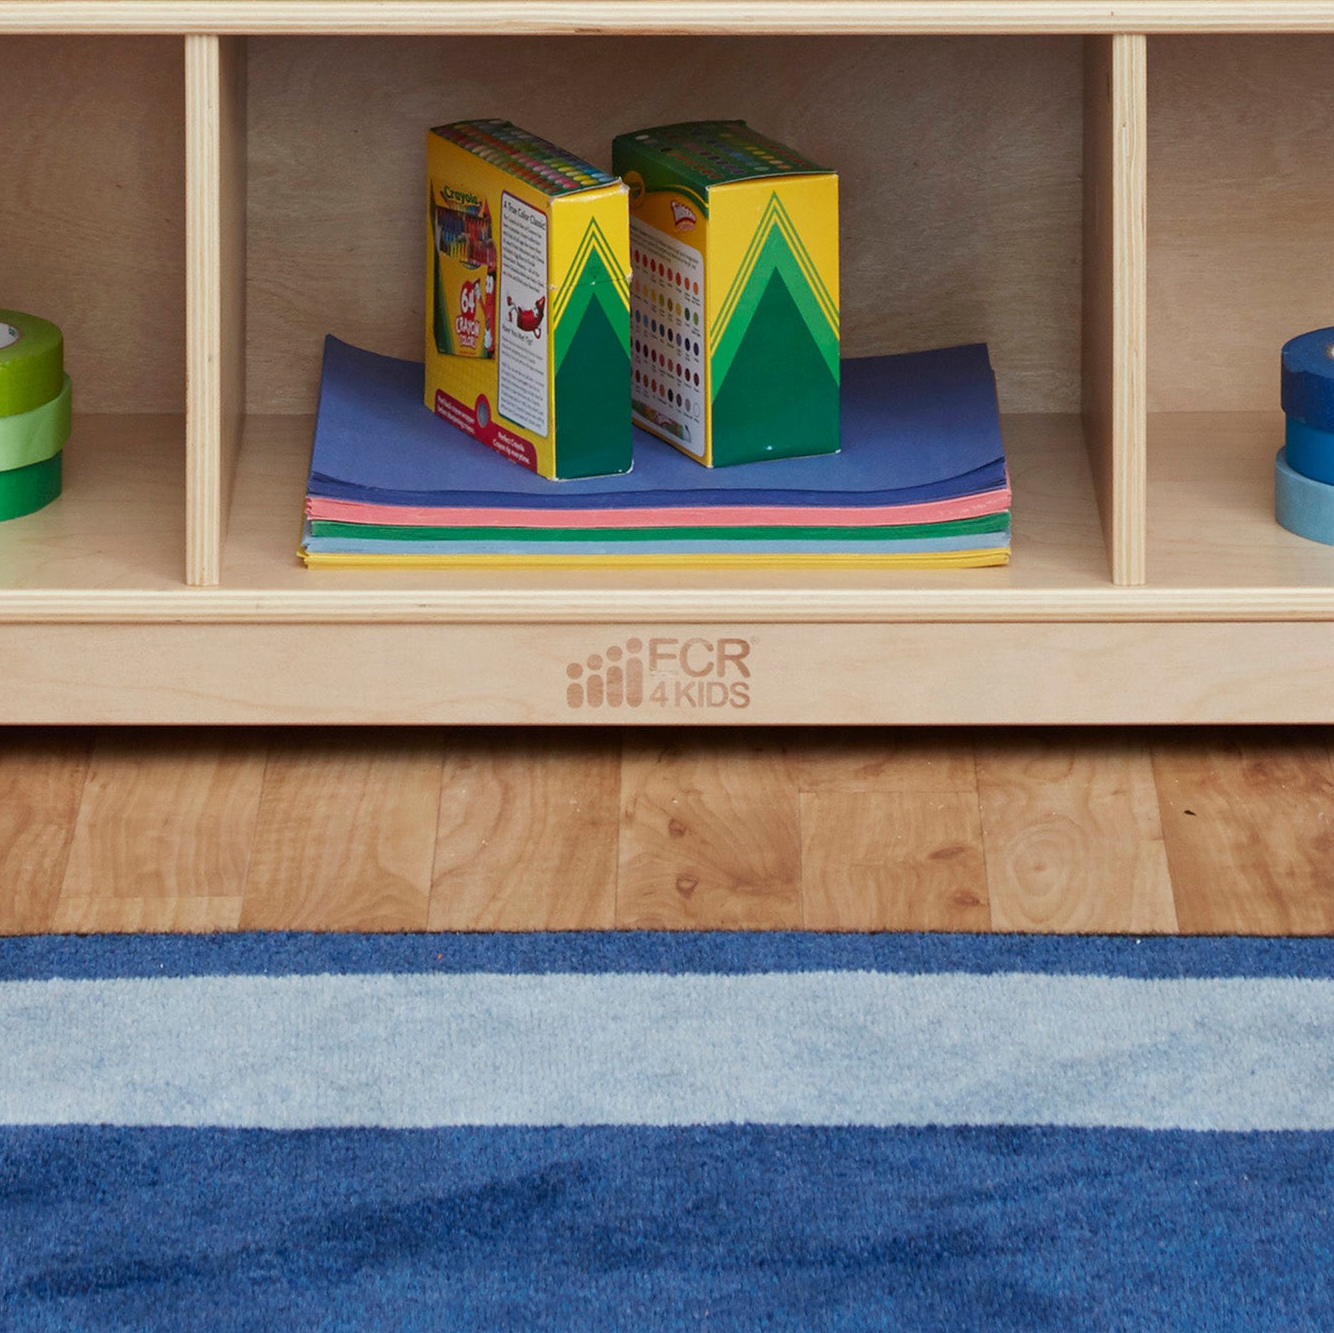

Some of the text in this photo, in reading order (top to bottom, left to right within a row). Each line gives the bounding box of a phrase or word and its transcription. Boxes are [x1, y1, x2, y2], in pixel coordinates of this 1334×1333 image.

[460, 287, 476, 314] 64
[648, 637, 752, 679] FCR
[649, 680, 751, 709] 4 KIDS
